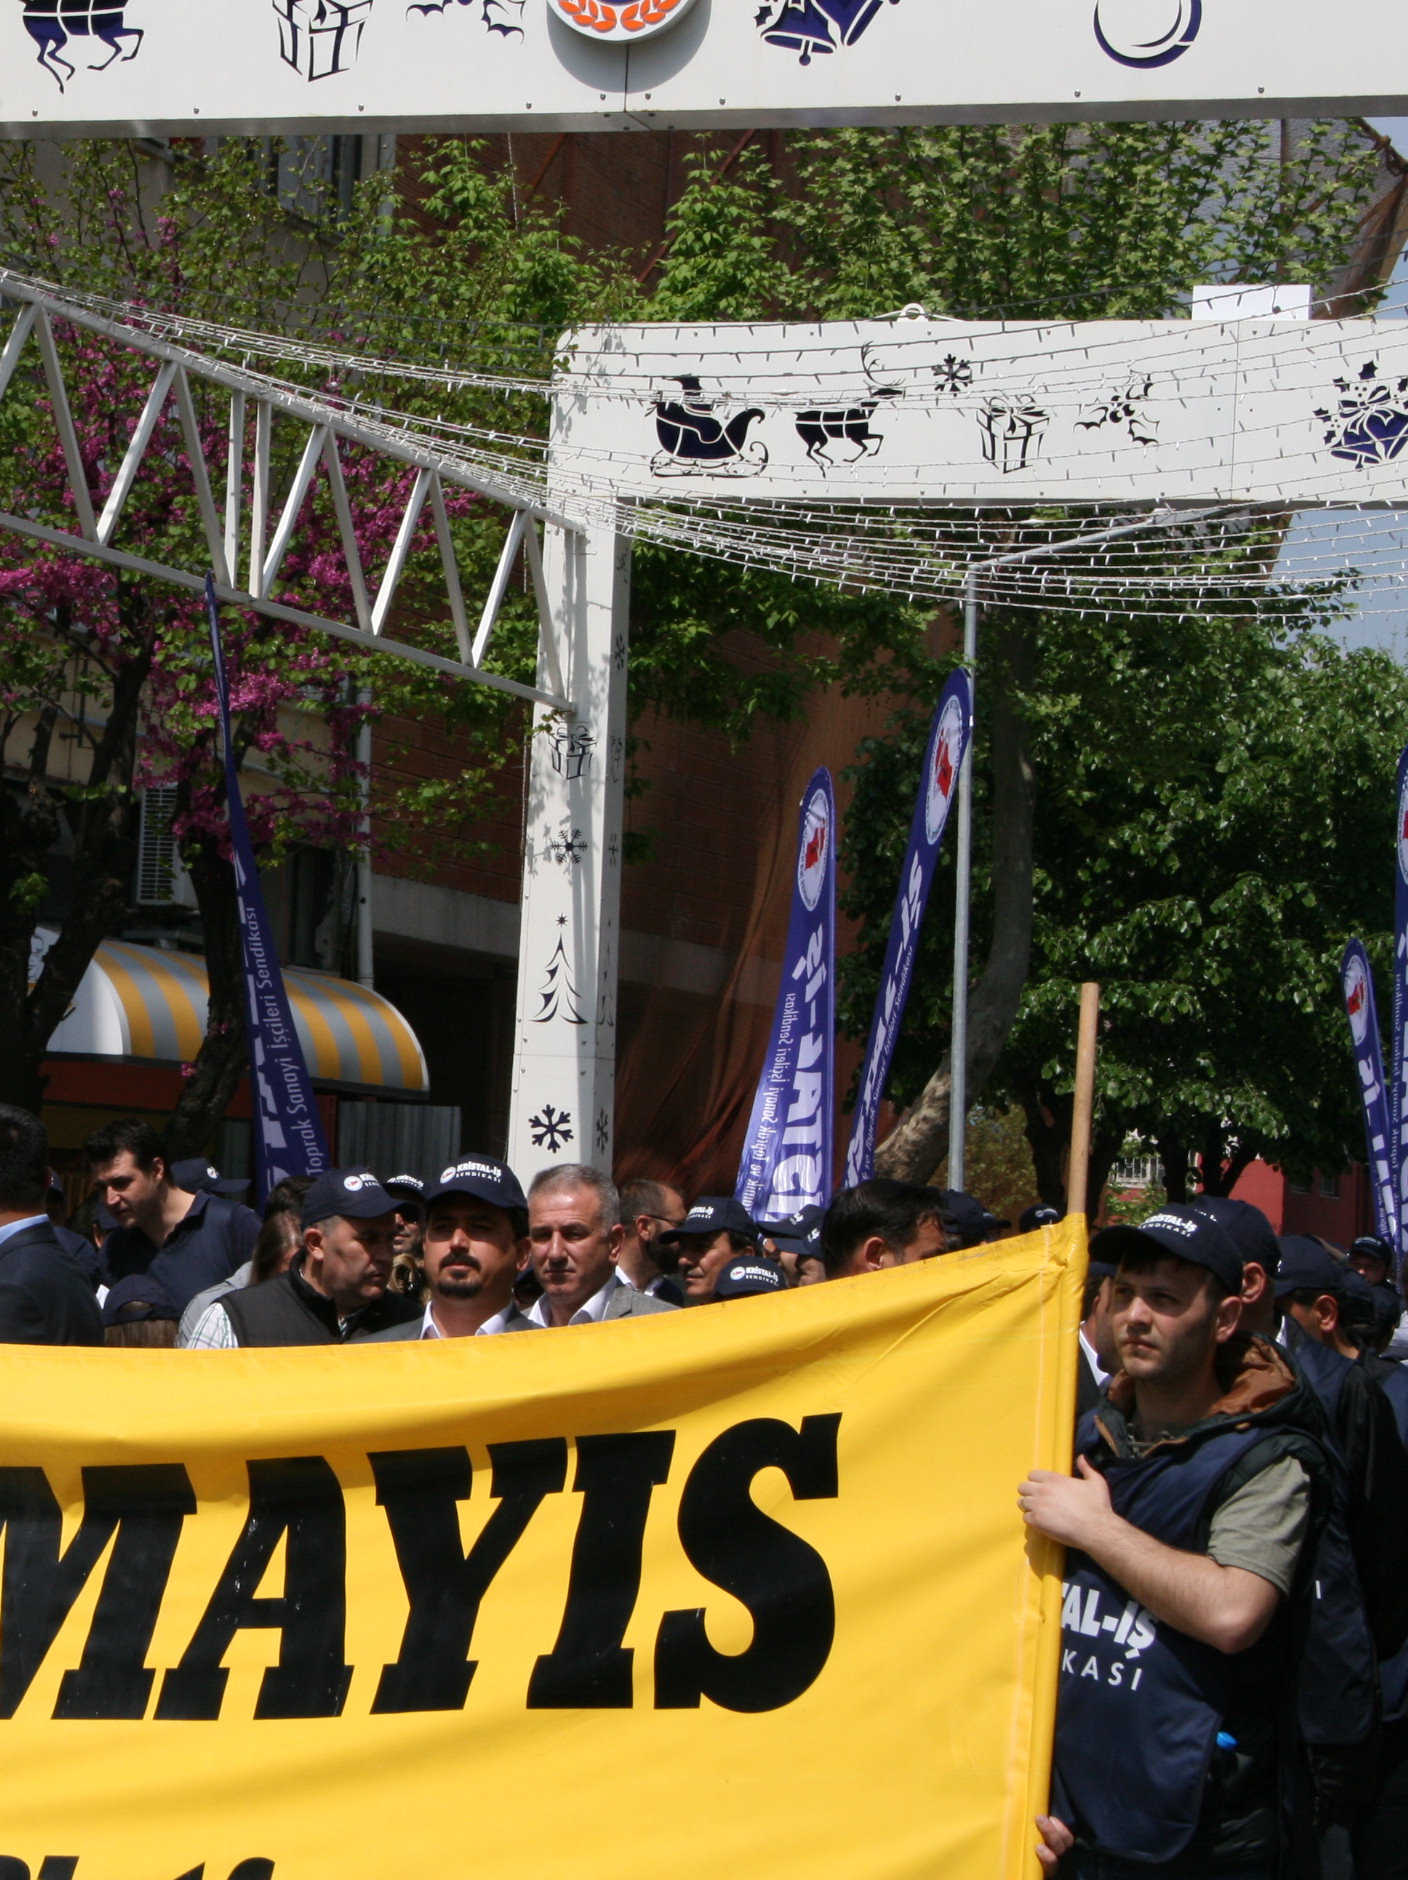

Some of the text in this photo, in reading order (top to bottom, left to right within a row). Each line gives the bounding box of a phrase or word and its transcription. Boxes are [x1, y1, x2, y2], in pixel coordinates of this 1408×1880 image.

[246, 907, 273, 989] Sendikası
[260, 995, 291, 1049] İşçileri
[274, 1057, 308, 1114] Sanayi
[290, 1119, 324, 1176] Toprak
[456, 1161, 502, 1178] KRİSTAL-İŞ
[456, 1171, 501, 1183] SENDİKASI
[1062, 1649, 1142, 1691] KASI
